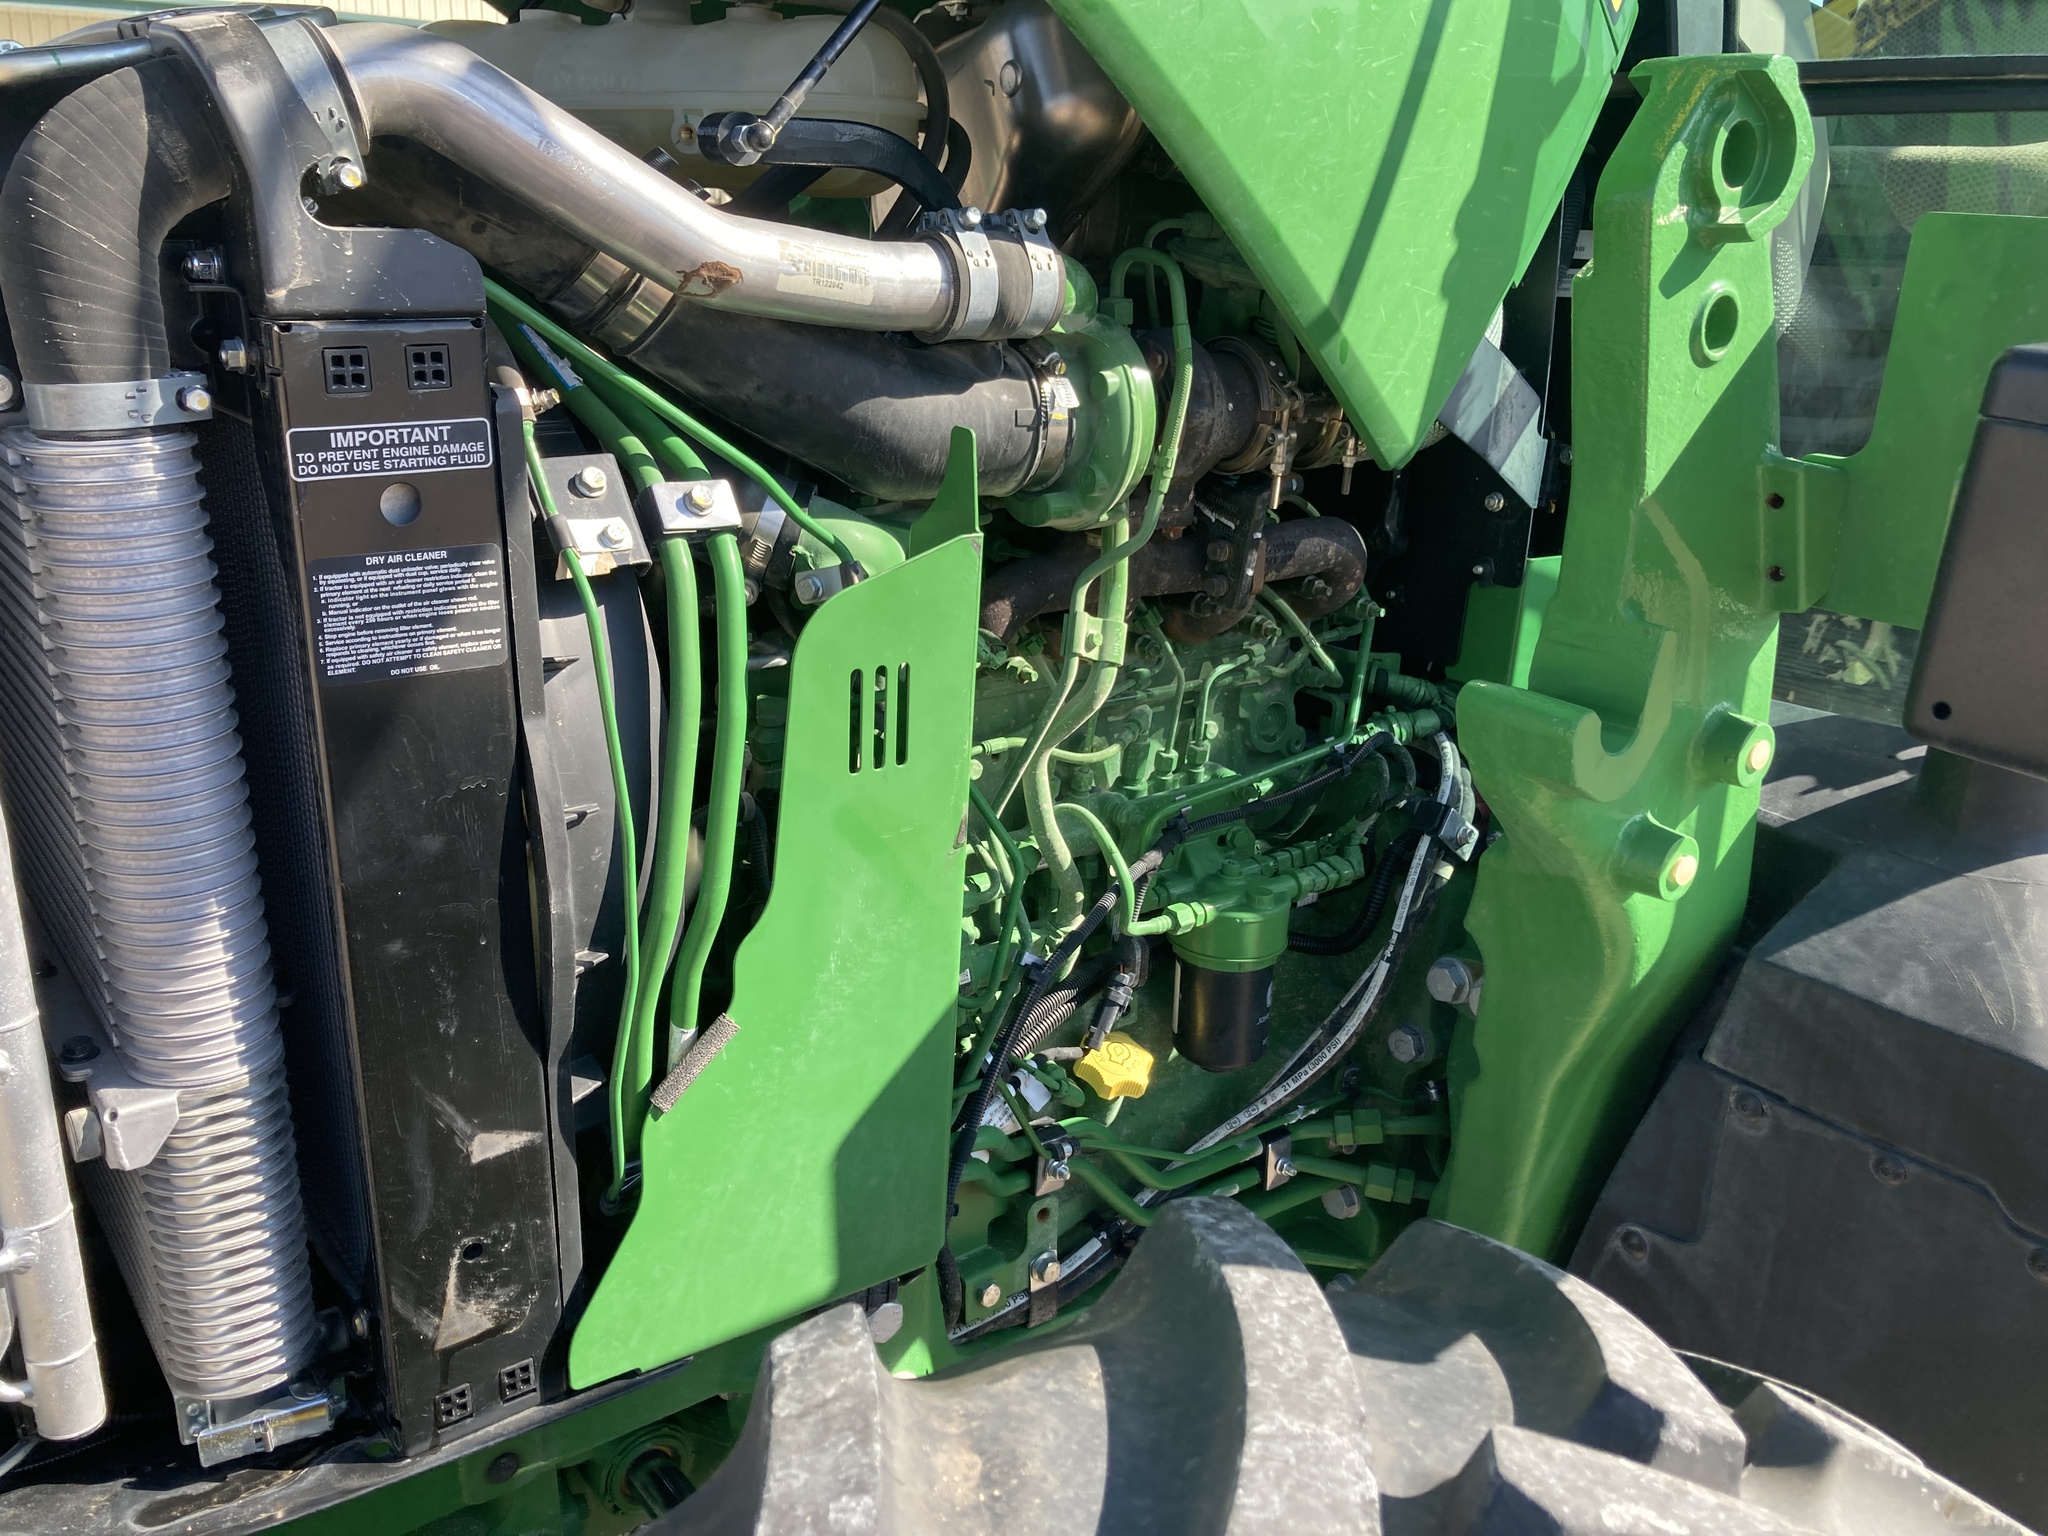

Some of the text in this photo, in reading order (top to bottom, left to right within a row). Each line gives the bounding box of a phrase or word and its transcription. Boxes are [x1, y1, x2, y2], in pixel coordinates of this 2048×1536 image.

[330, 426, 451, 448] IMPORTANT
[296, 442, 485, 463] TO PREVENT ENGINE DAMAGE
[298, 453, 486, 475] DO NOT USE STARTING FLUID
[365, 551, 447, 565] DRY AIR CLEANER
[1392, 894, 1412, 930] GLOBALCORE
[1384, 931, 1399, 959] Parker
[1281, 1037, 1342, 1093] 21 MPa (3000 PSI)
[951, 1326, 963, 1335] 21
